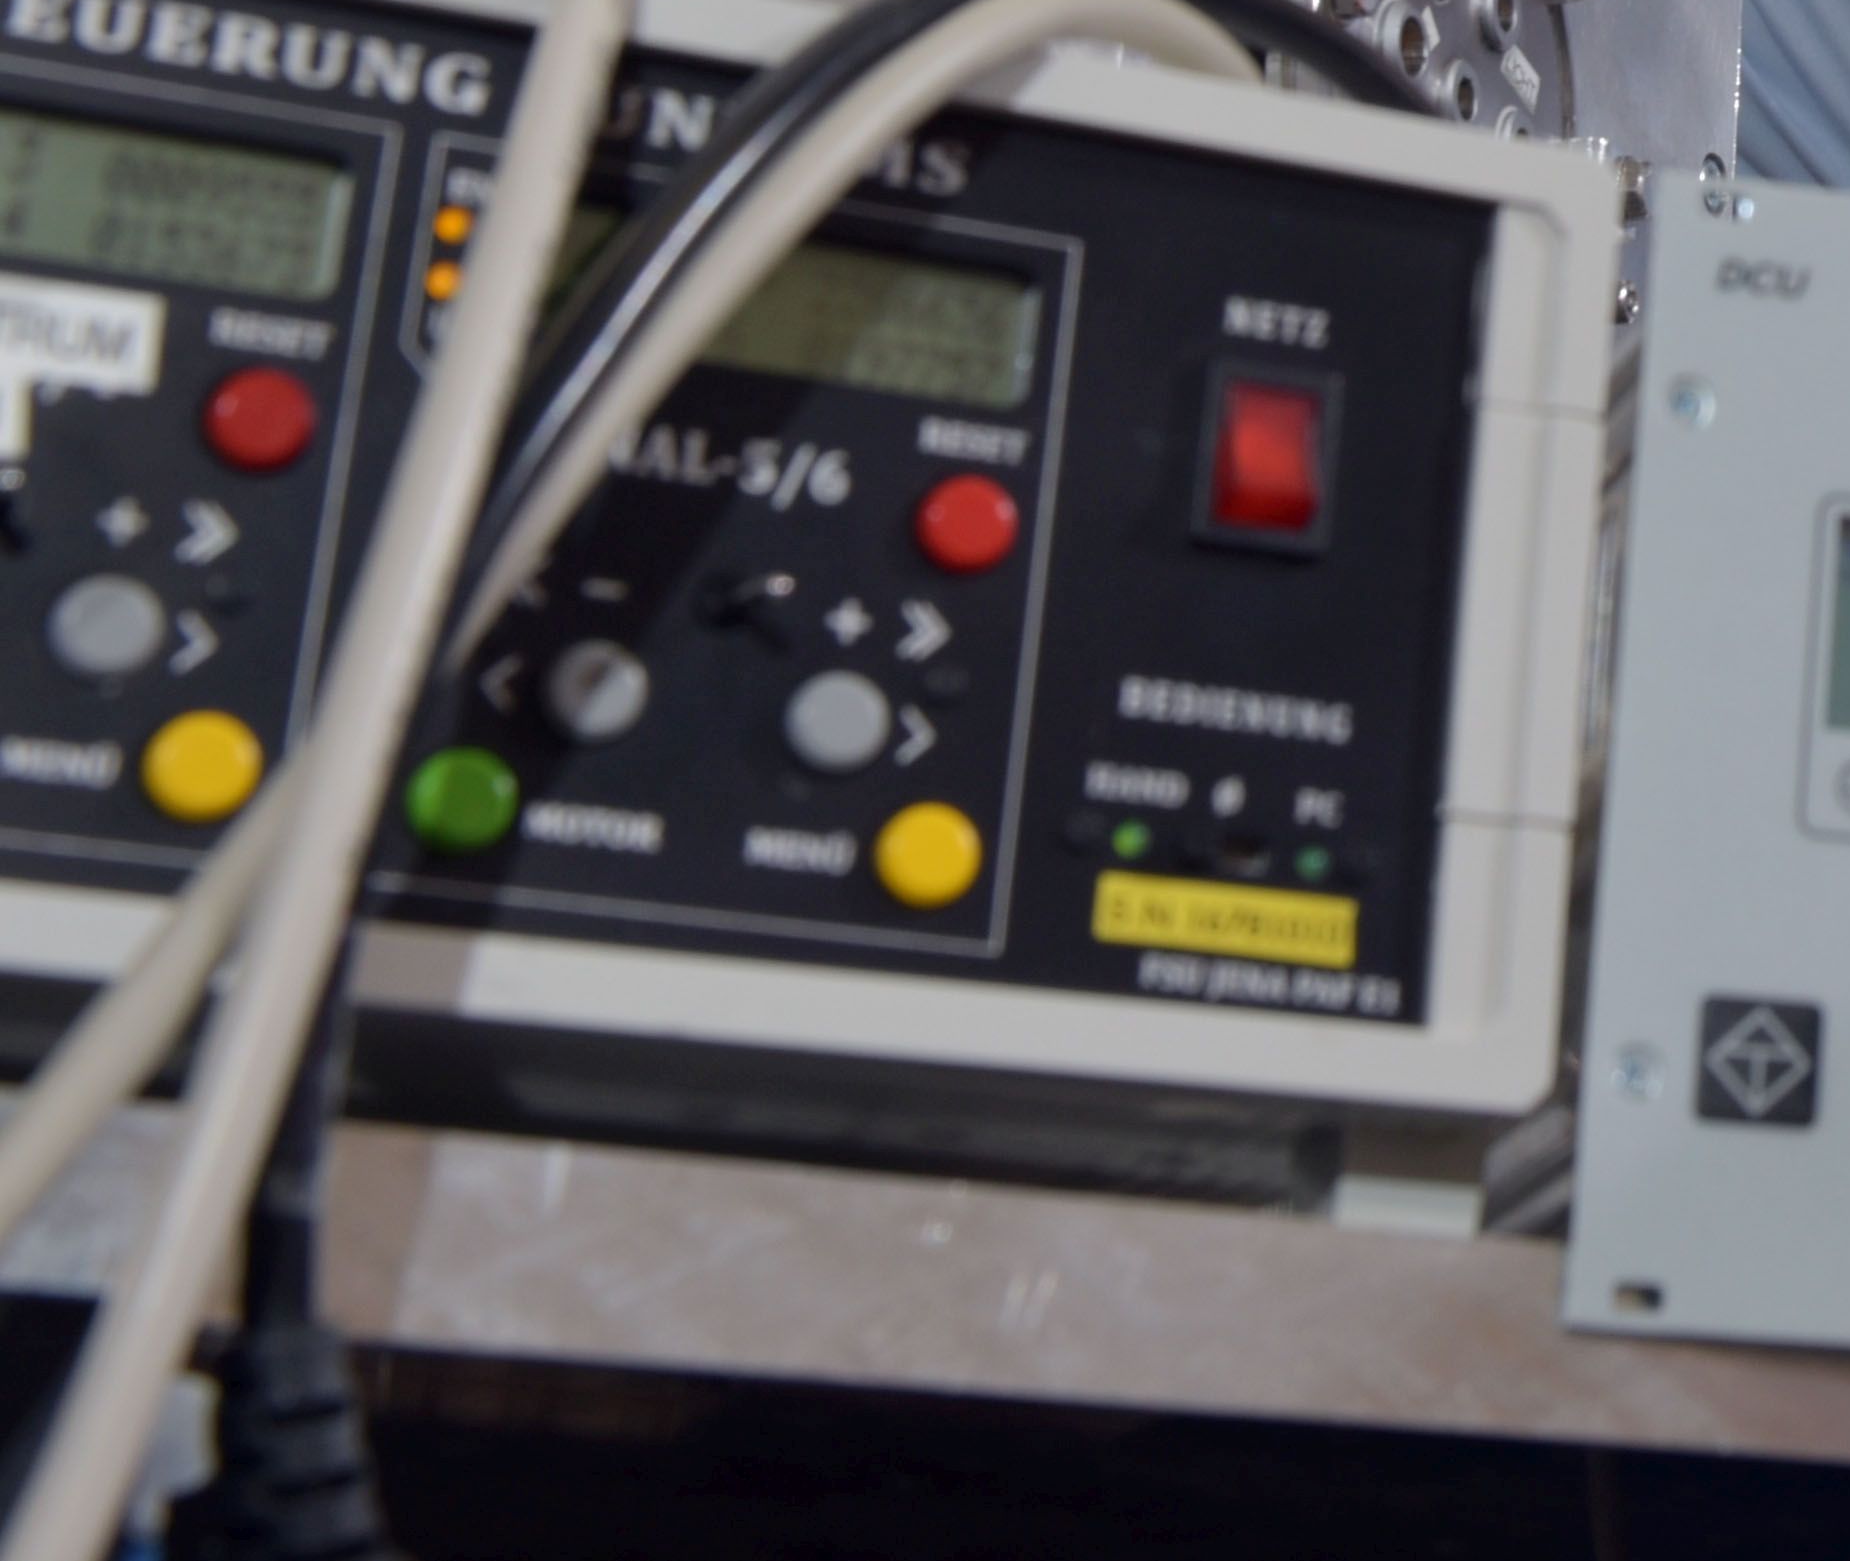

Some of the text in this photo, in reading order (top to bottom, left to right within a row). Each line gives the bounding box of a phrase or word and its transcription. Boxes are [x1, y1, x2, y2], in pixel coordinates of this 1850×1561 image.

[1715, 258, 1809, 301] DCU
[209, 307, 335, 363] RESET
[1222, 294, 1330, 350] NETZ
[918, 414, 1030, 466] RESET
[1118, 674, 1354, 746] BEDIENUNG
[1293, 786, 1345, 830] PC
